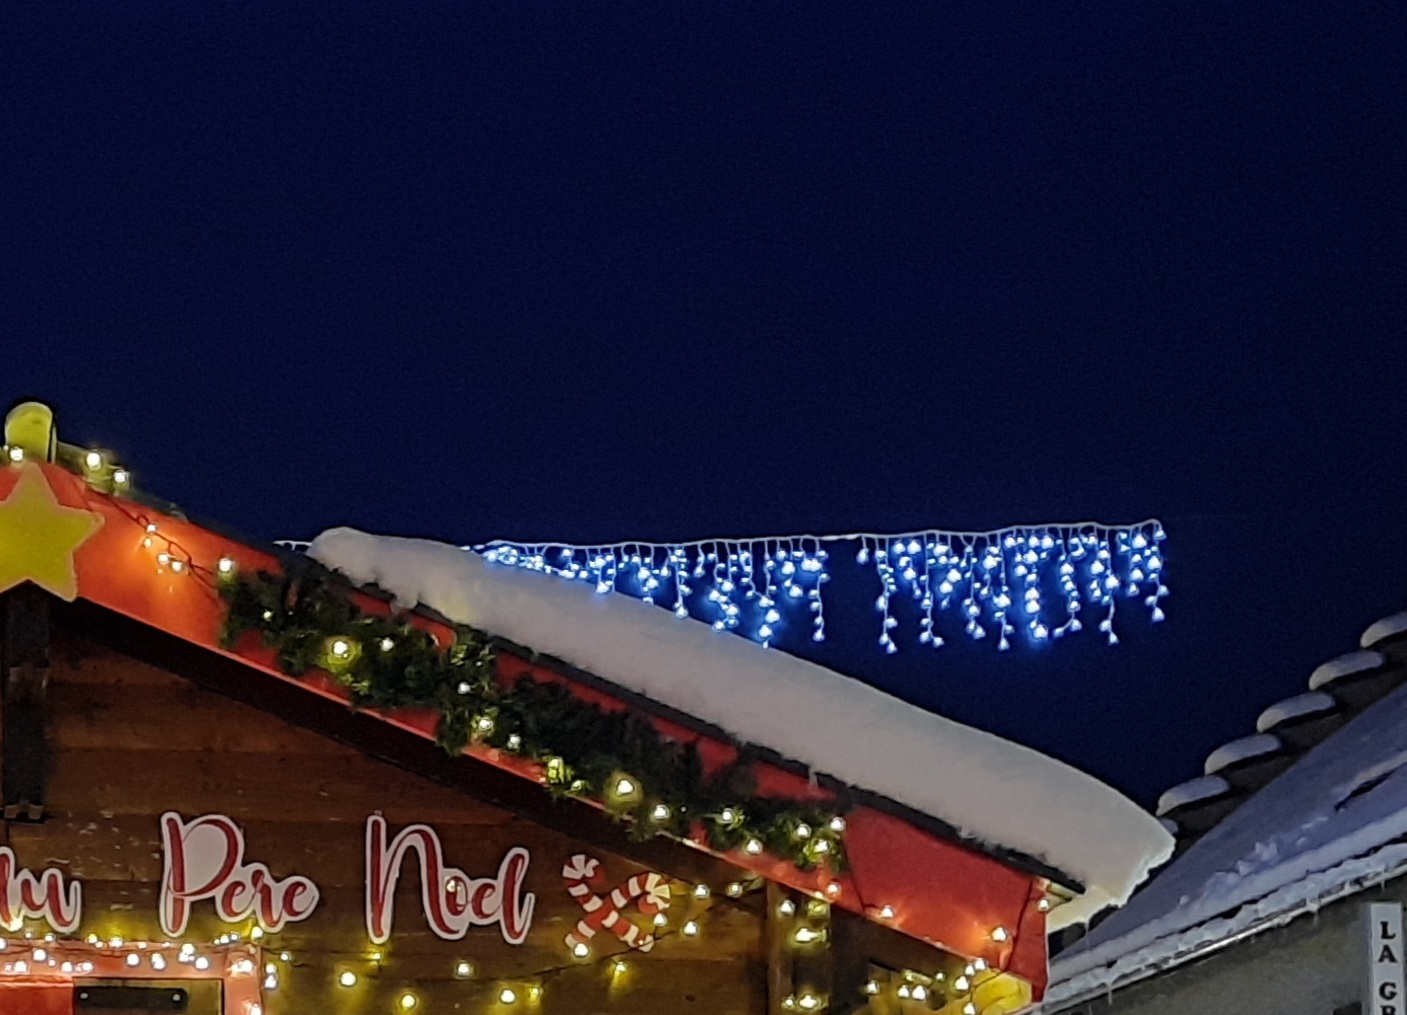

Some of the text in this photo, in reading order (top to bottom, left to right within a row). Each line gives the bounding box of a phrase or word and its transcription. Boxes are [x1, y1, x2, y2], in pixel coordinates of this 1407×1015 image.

[160, 812, 320, 938] Pere
[365, 815, 535, 945] Noel
[1378, 921, 1397, 963] LA
